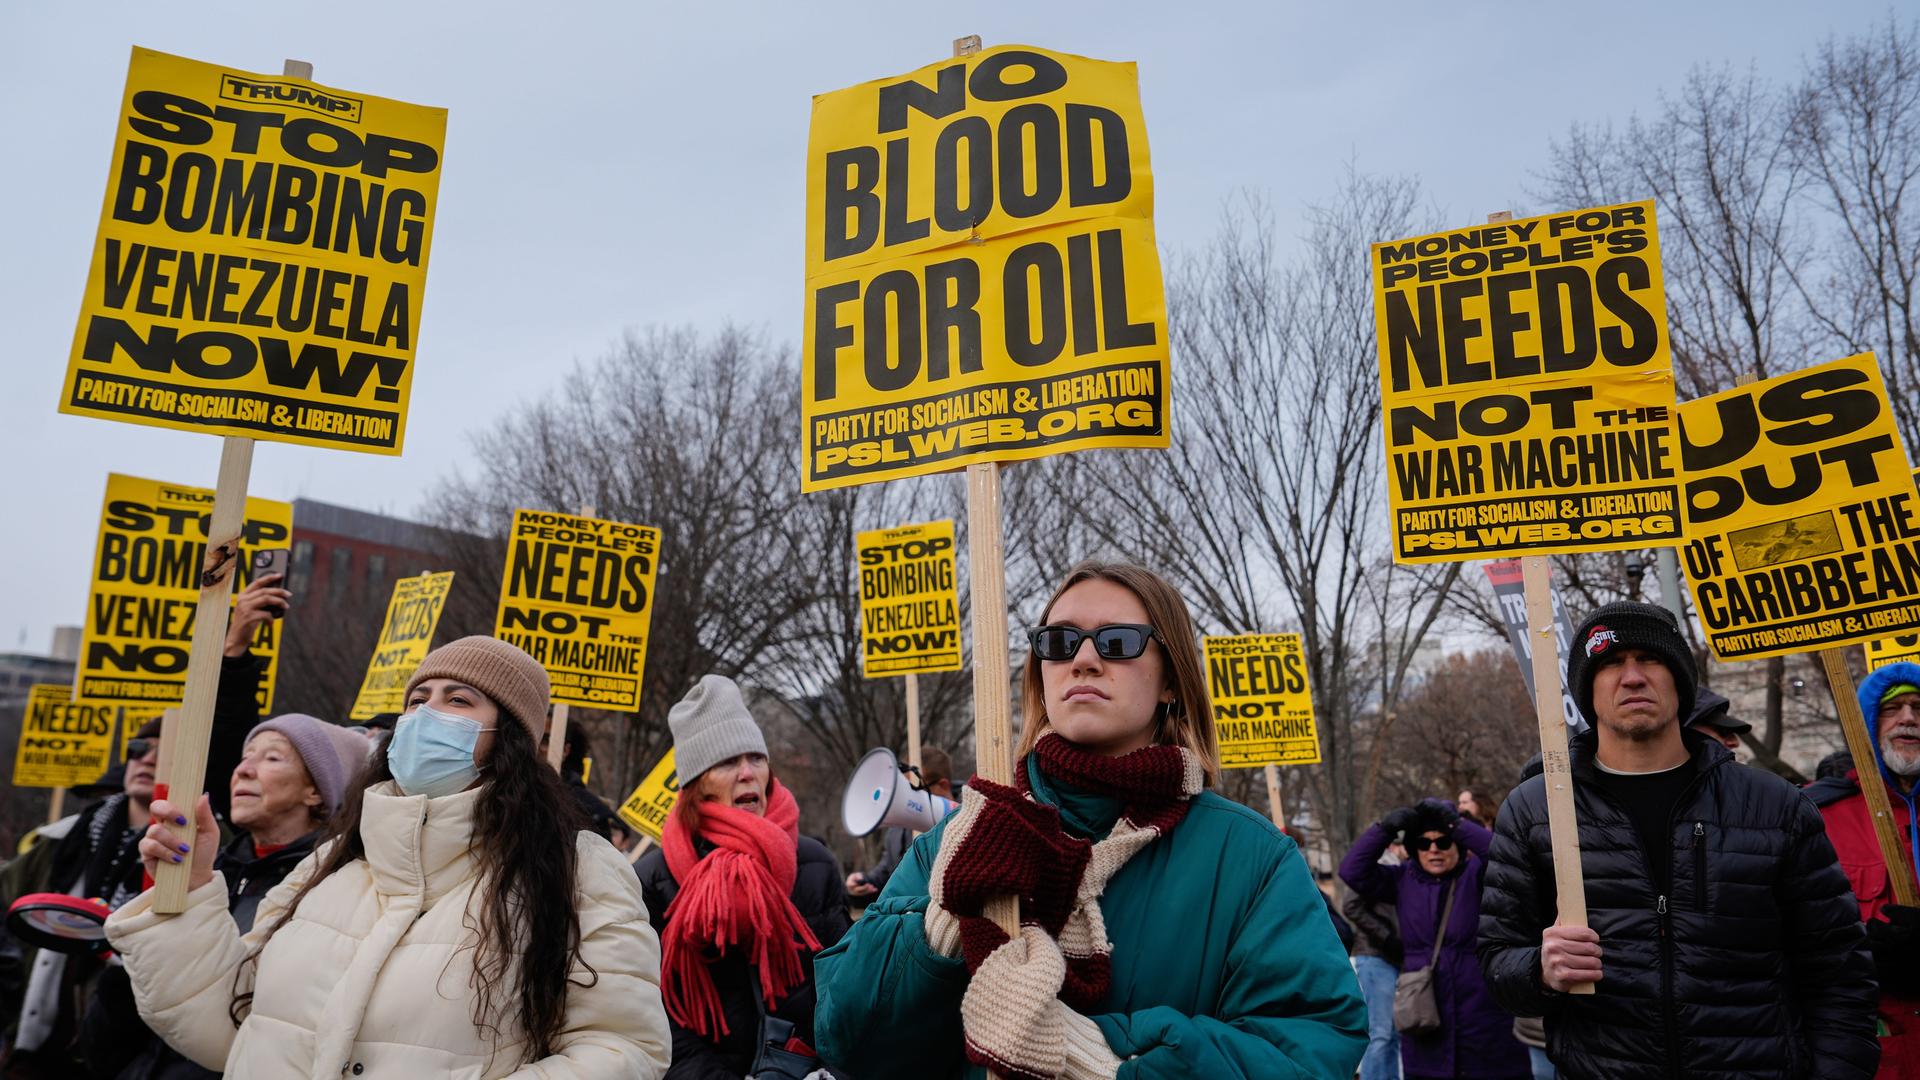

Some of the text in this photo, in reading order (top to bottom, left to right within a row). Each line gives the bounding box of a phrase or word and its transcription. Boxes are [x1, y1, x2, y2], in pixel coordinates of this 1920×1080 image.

[227, 80, 356, 118] TRUMP:
[878, 50, 1068, 134] NO
[128, 90, 438, 179] STOP
[112, 139, 427, 267] BOMBING
[824, 102, 1132, 262] BLOOD
[1381, 206, 1647, 265] MONEY FOR
[1382, 228, 1649, 289] PEOPLE'S
[103, 238, 410, 351] VENEZUELA
[814, 228, 1157, 402] FOR OIL
[1385, 255, 1659, 393] NEEDS
[82, 314, 409, 404] NOW!
[77, 377, 393, 441] PARTY FOR SOCIALISM & LIBERATION
[815, 367, 1155, 446] PARTY FOR SOCIALISM & LIBERATION
[1390, 385, 1669, 447] NOT THE
[1677, 368, 1882, 472] US
[815, 400, 1155, 474] PSLWEB.ORG
[1393, 427, 1676, 502] WAR MACHINE
[1685, 433, 1895, 524] OUT
[519, 512, 656, 541] MONEY FOR
[1401, 490, 1673, 532] PARTY FOR SOCIALISM & LIBERATION
[1403, 514, 1674, 553] PSLWEB.ORG
[1839, 492, 1920, 548] THE
[517, 525, 654, 555] PEOPLE'S
[860, 537, 952, 566] STOP
[1683, 534, 1724, 581] OF
[509, 540, 651, 614] NEEDS
[862, 558, 953, 600] BOMBING
[1696, 540, 1920, 630] CARIBBEAN
[383, 596, 441, 645] NEEDS
[502, 607, 643, 645] NOT THE
[865, 598, 956, 634] VENEZUELA
[1206, 634, 1297, 646] MONEY FOR
[1715, 633, 1754, 653] PARTY
[1752, 629, 1779, 648] FOR
[1776, 618, 1844, 644] SOCIALISM
[1844, 616, 1864, 633] &
[374, 648, 410, 667] NOT
[551, 638, 641, 675] MACHINE
[867, 630, 957, 655] NOW!
[1208, 643, 1298, 656] PEOPLE'S
[1210, 653, 1305, 699] NEEDS
[29, 702, 111, 736] NEEDS
[1214, 701, 1285, 720] NOT
[1216, 718, 1313, 742] WAR MACHINE
[25, 738, 87, 751] NOT
